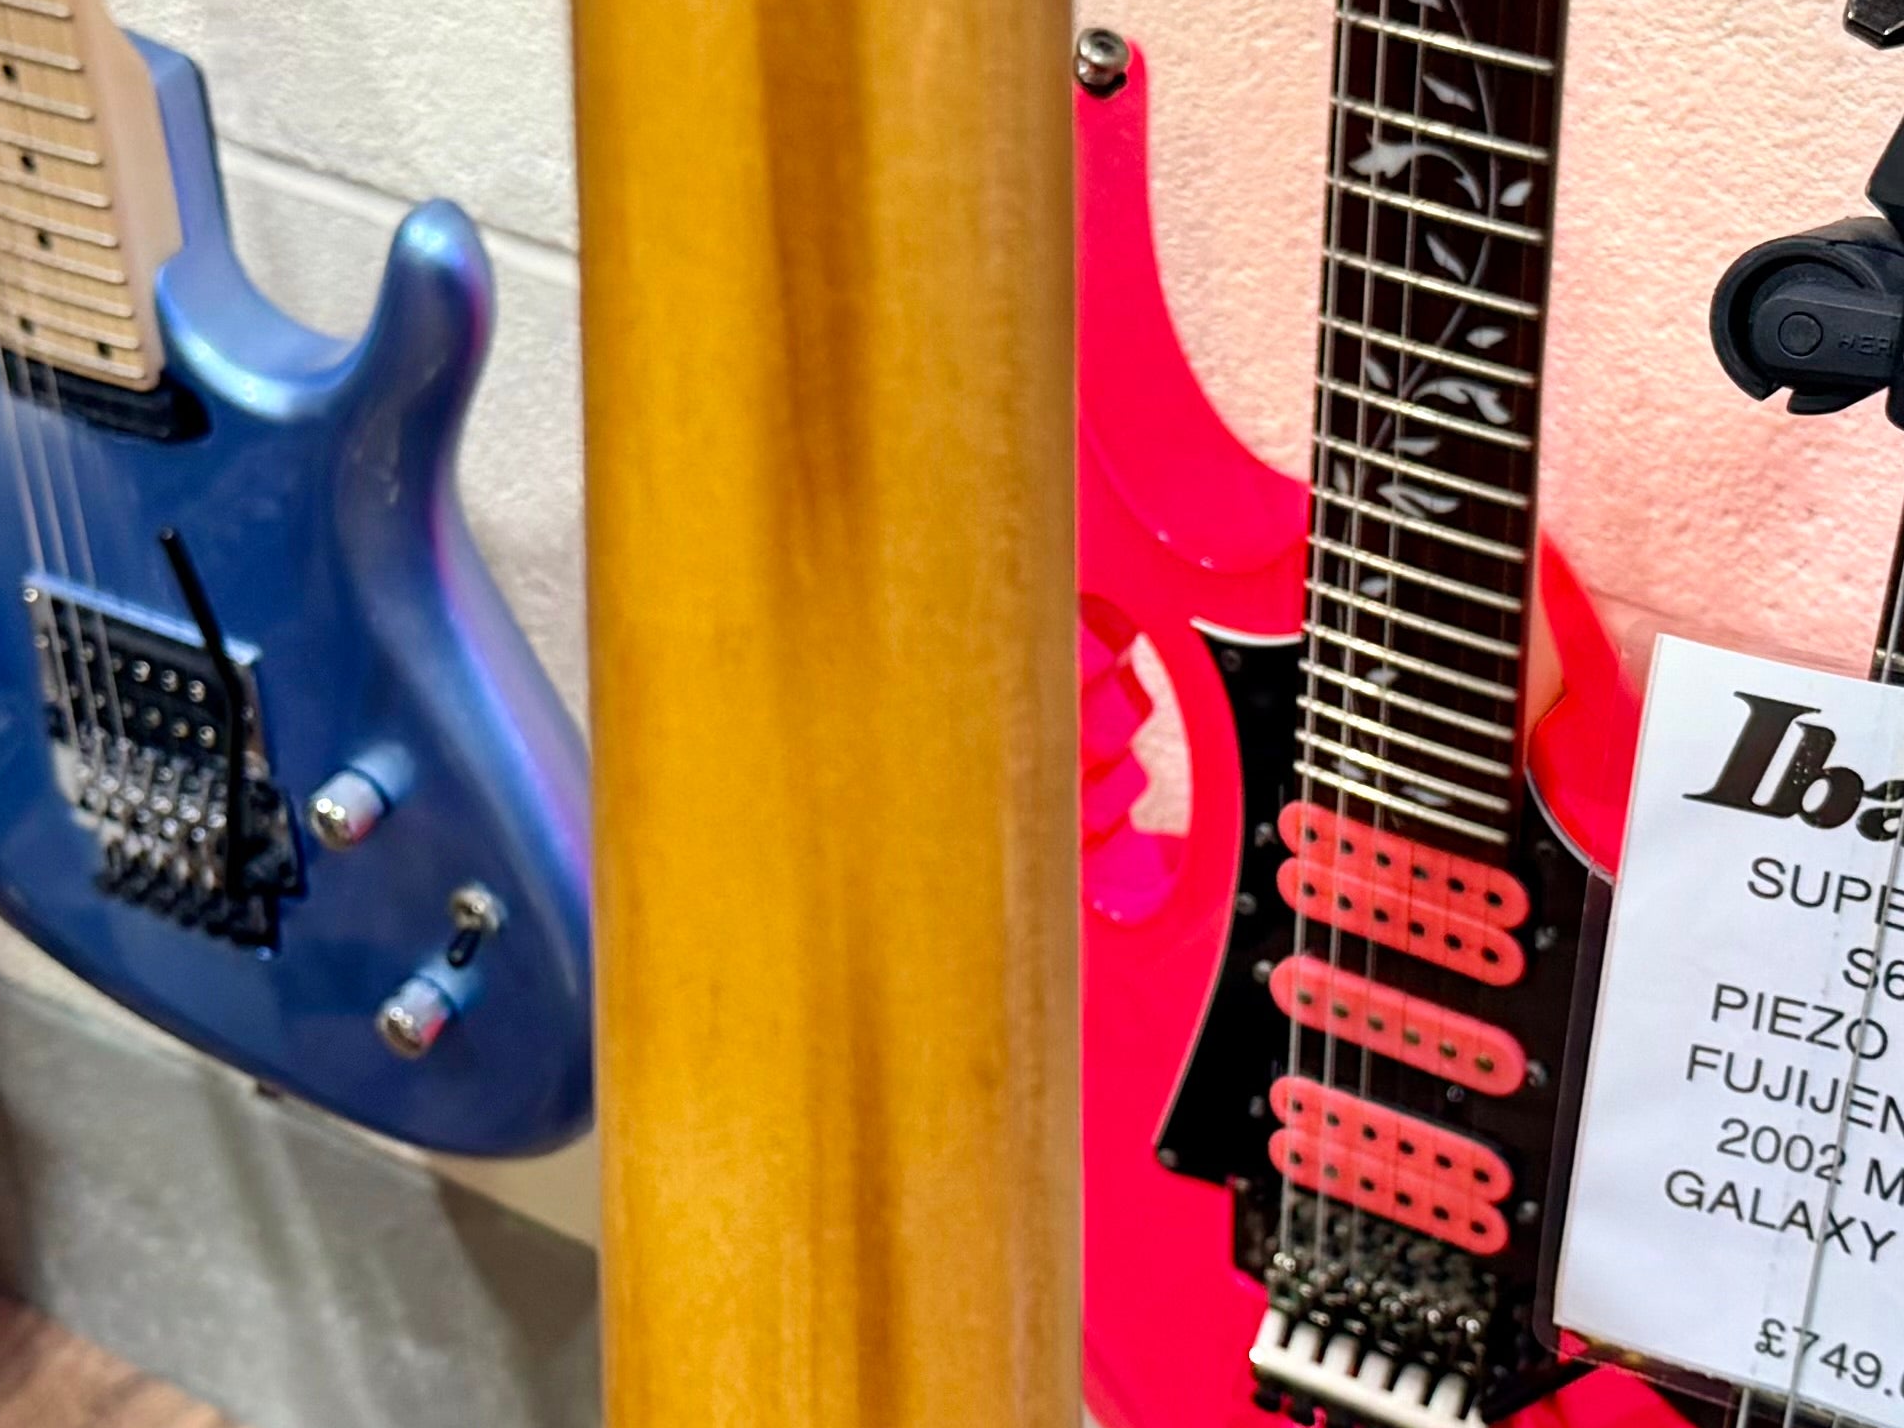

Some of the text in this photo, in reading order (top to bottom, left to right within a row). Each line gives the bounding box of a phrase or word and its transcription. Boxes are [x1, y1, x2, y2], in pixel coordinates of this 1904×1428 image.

[1710, 982, 1888, 1062] PIEZO
[1716, 1117, 1847, 1186] 2002
[1665, 1169, 1896, 1264] GALAXY
